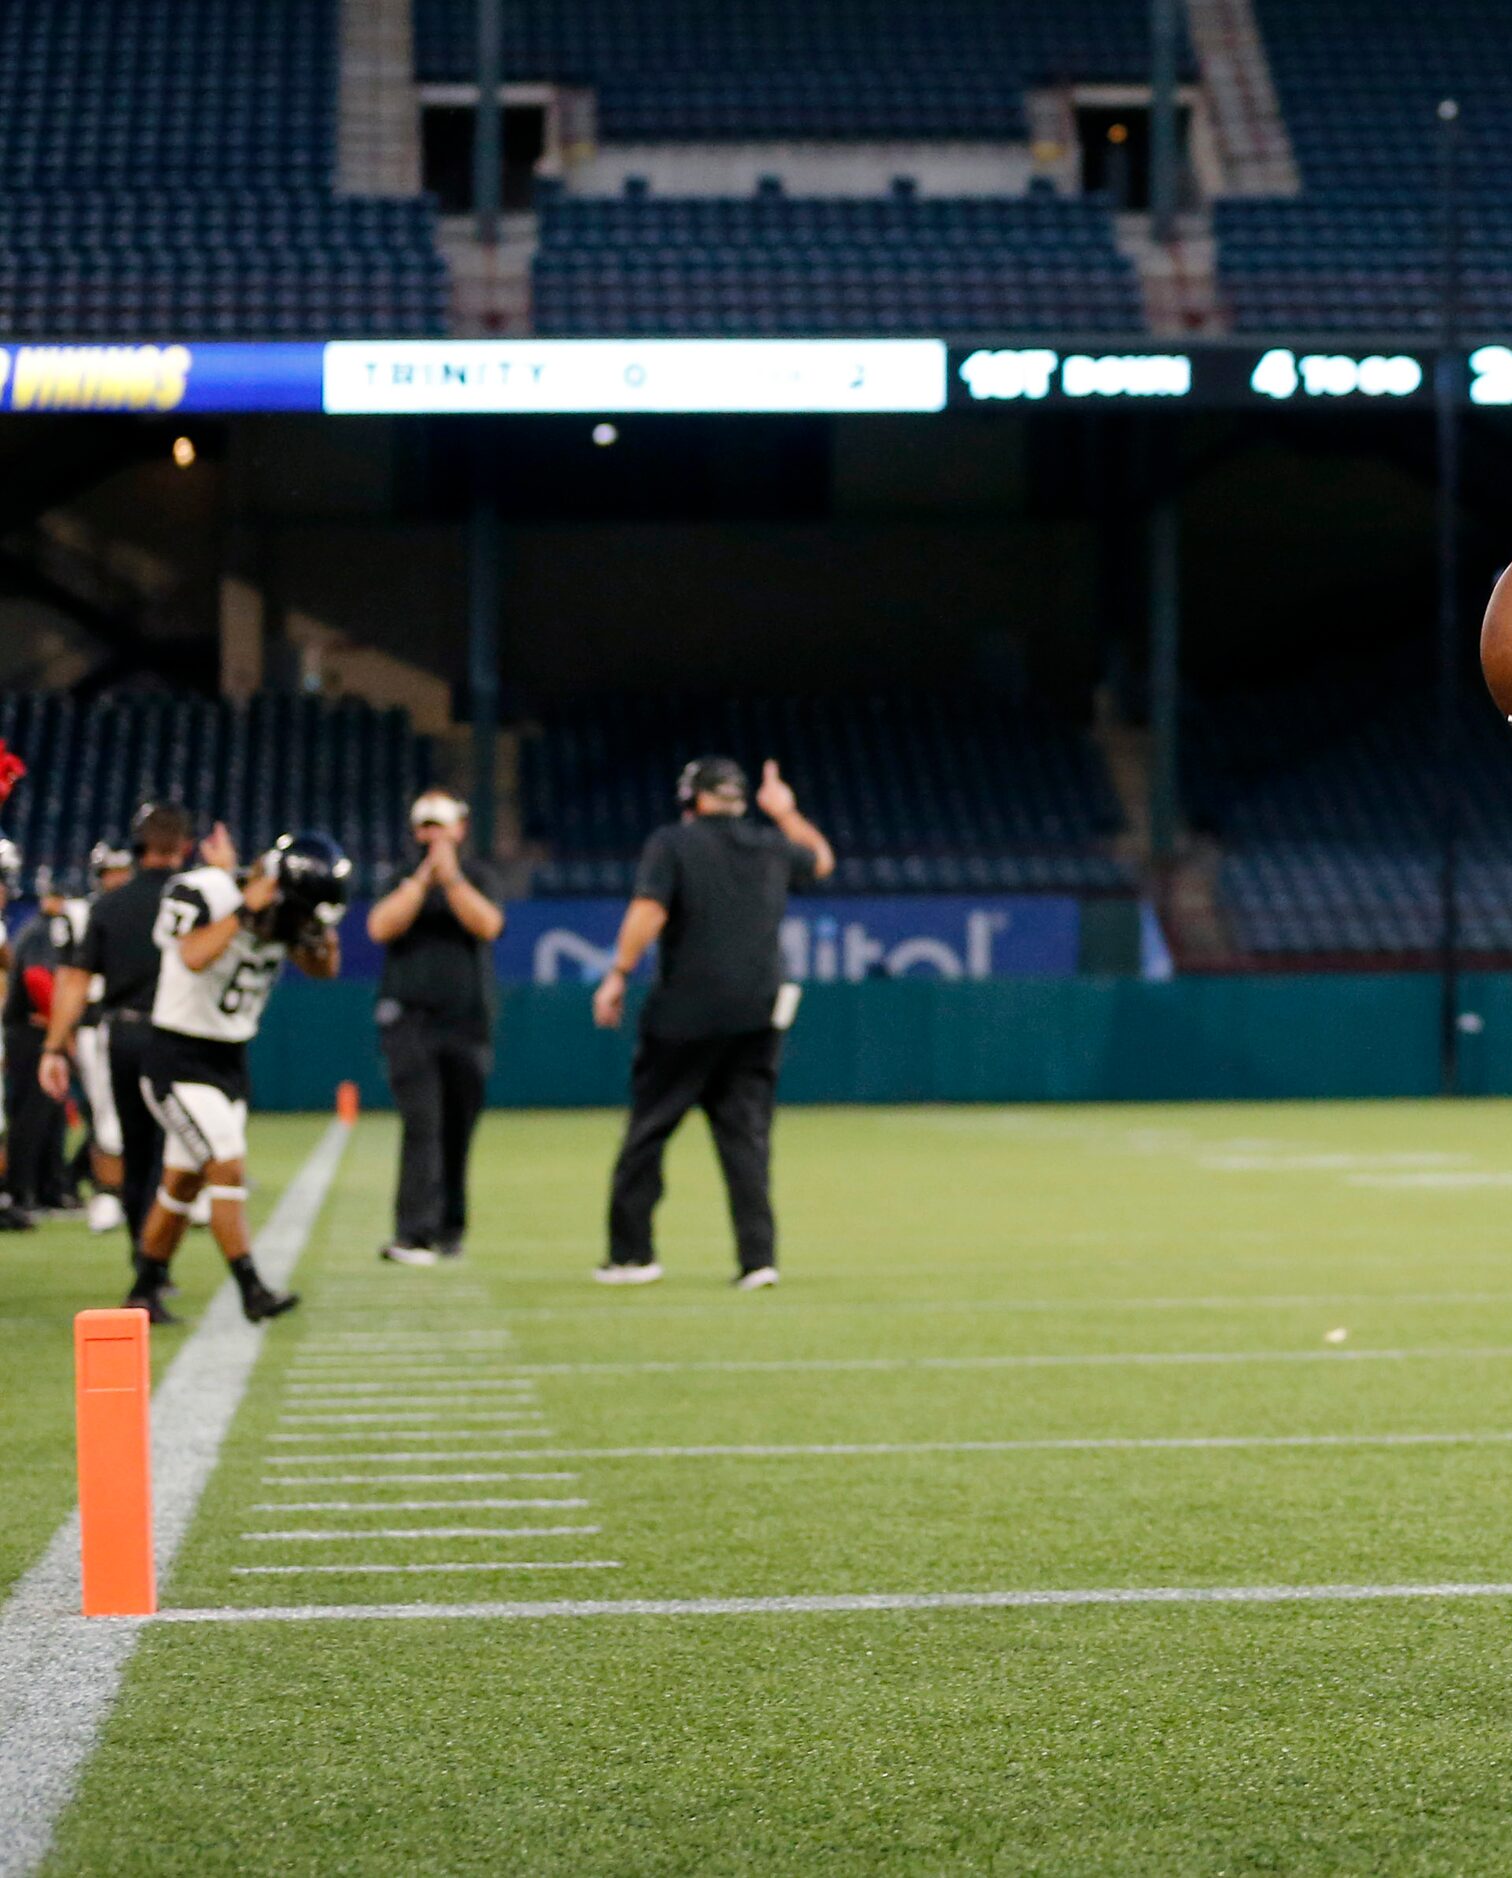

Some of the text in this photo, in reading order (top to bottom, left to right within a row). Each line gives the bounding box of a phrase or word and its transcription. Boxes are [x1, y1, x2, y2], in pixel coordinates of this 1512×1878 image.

[362, 360, 548, 387] TRINITY
[959, 349, 1057, 399] 1ST
[1252, 348, 1297, 399] 4
